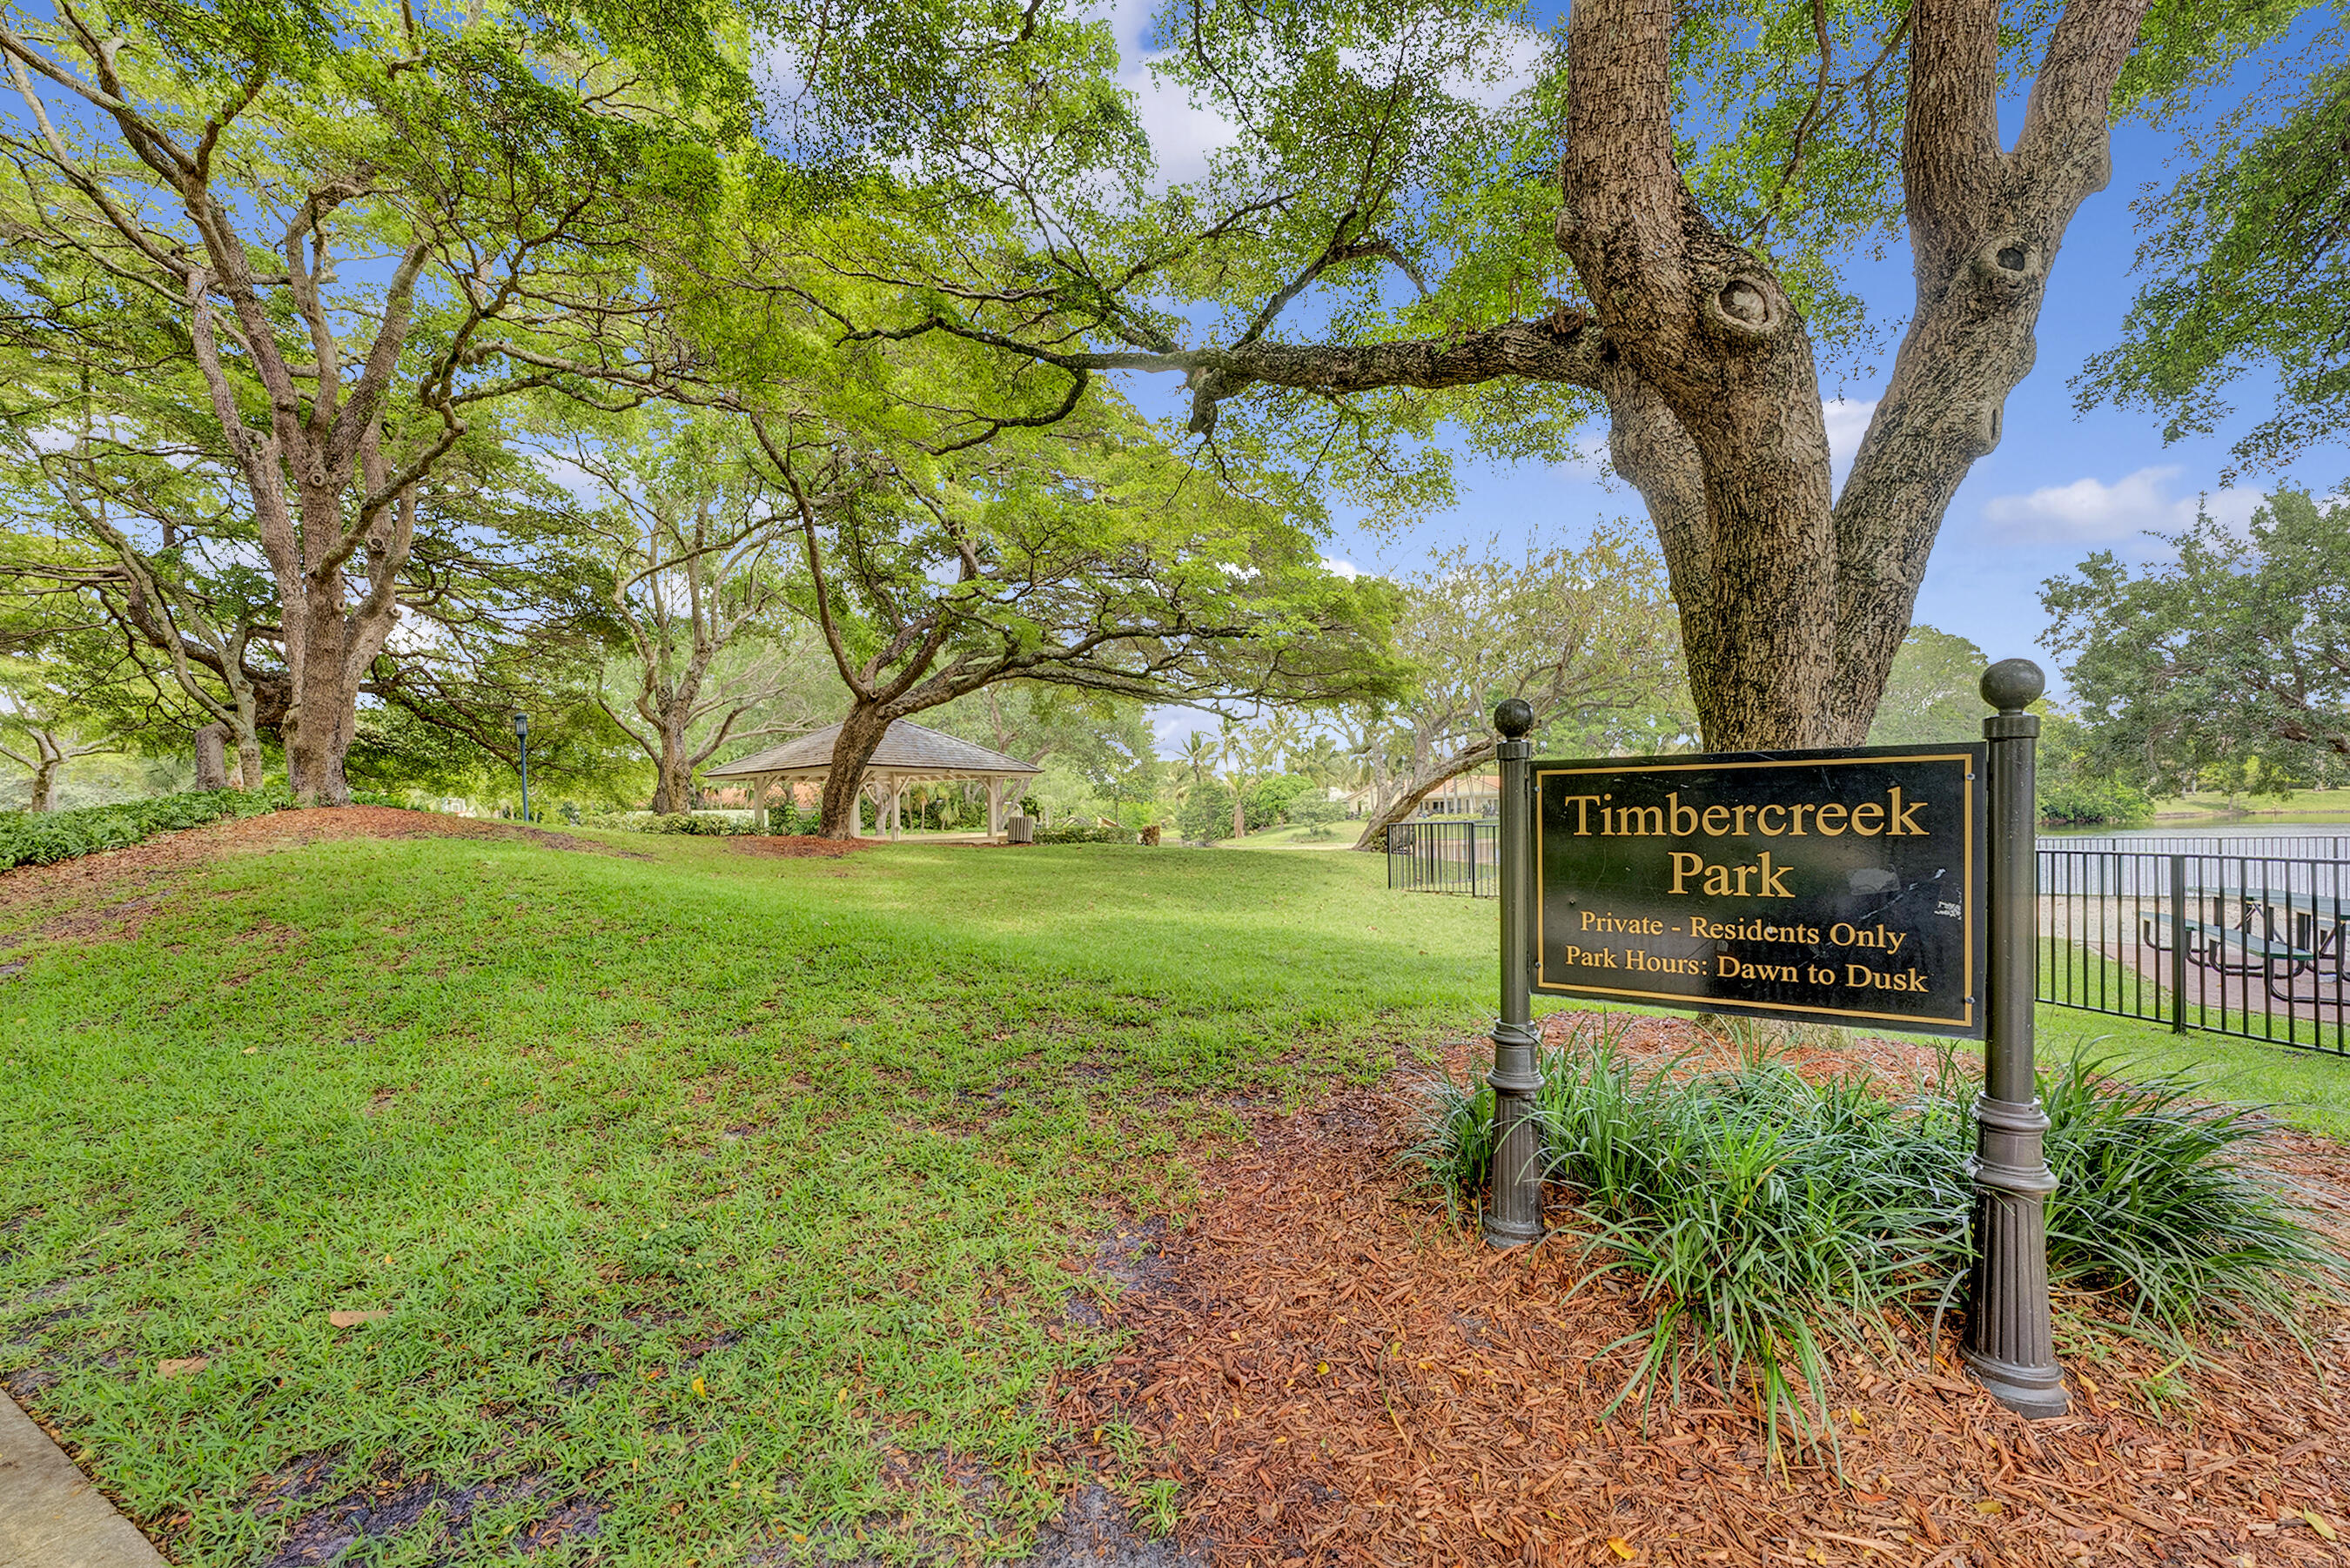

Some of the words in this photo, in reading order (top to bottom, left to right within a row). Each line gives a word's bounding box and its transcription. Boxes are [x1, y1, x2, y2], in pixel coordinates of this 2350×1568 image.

[1565, 787, 1929, 836] Timbercreek
[1668, 851, 1795, 897] Park
[1581, 911, 1663, 935] Private
[1689, 916, 1819, 944] Residents
[1830, 923, 1906, 955] Only
[1566, 945, 1618, 968] Park
[1626, 949, 1707, 975] Hours:
[1717, 955, 1798, 982] Dawn
[1808, 964, 1835, 985] to
[1845, 964, 1929, 992] Dusk
